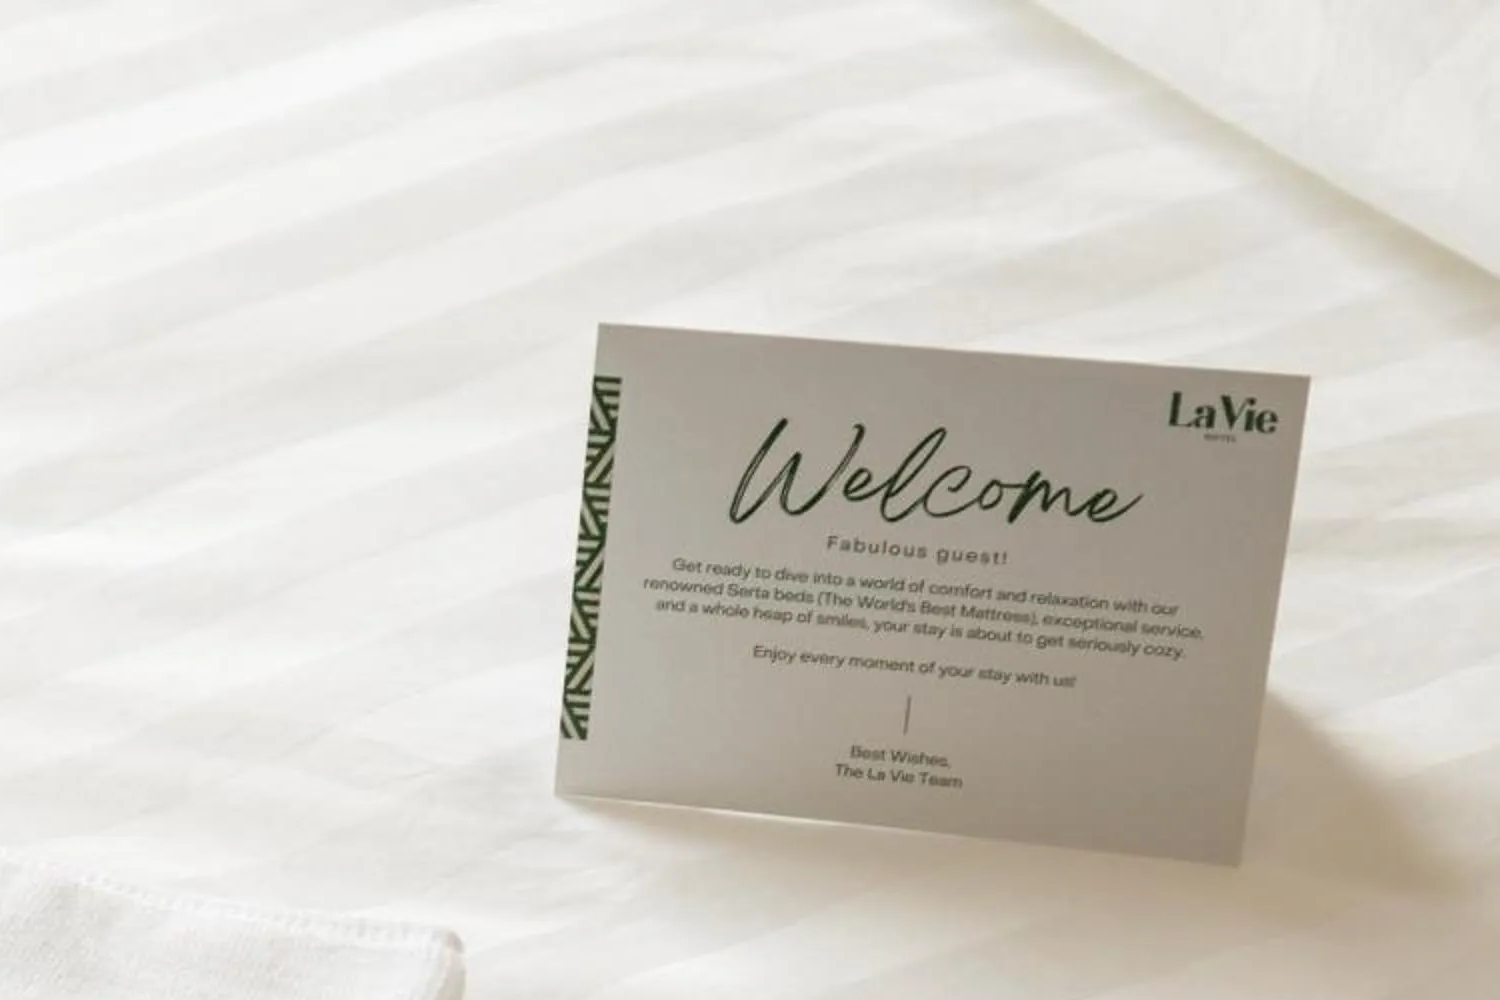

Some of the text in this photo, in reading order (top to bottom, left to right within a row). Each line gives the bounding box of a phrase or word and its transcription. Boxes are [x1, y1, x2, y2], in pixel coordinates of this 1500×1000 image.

[729, 417, 1144, 524] Welcome
[827, 535, 1008, 566] Fabulous guest!
[644, 578, 723, 595] renowned
[727, 583, 770, 599] Serta
[774, 587, 814, 603] beds
[818, 591, 852, 608] (The
[920, 601, 956, 616] Best
[1042, 615, 1137, 633] exceptional
[672, 557, 1179, 616] Get ready to dive into a world of comfort and relaxation with our
[656, 599, 685, 612] and
[689, 603, 698, 613] a
[702, 602, 749, 618] whole
[753, 606, 792, 624] heap
[796, 611, 812, 624] of
[816, 613, 870, 631] smiles,
[874, 620, 909, 634] your
[913, 622, 946, 640] stay
[950, 624, 962, 638] is
[967, 627, 1012, 642] about
[1017, 630, 1032, 644] to
[1036, 634, 1064, 649] get
[1068, 637, 1142, 656] seriously
[753, 645, 796, 665] Enjoy
[800, 653, 845, 670] every
[849, 657, 914, 672] moment
[918, 661, 936, 674] of
[939, 665, 973, 679] your
[978, 667, 1011, 685] stay
[1016, 670, 1049, 685] with
[836, 764, 963, 788] The La Vie Team
[850, 745, 886, 761] Best
